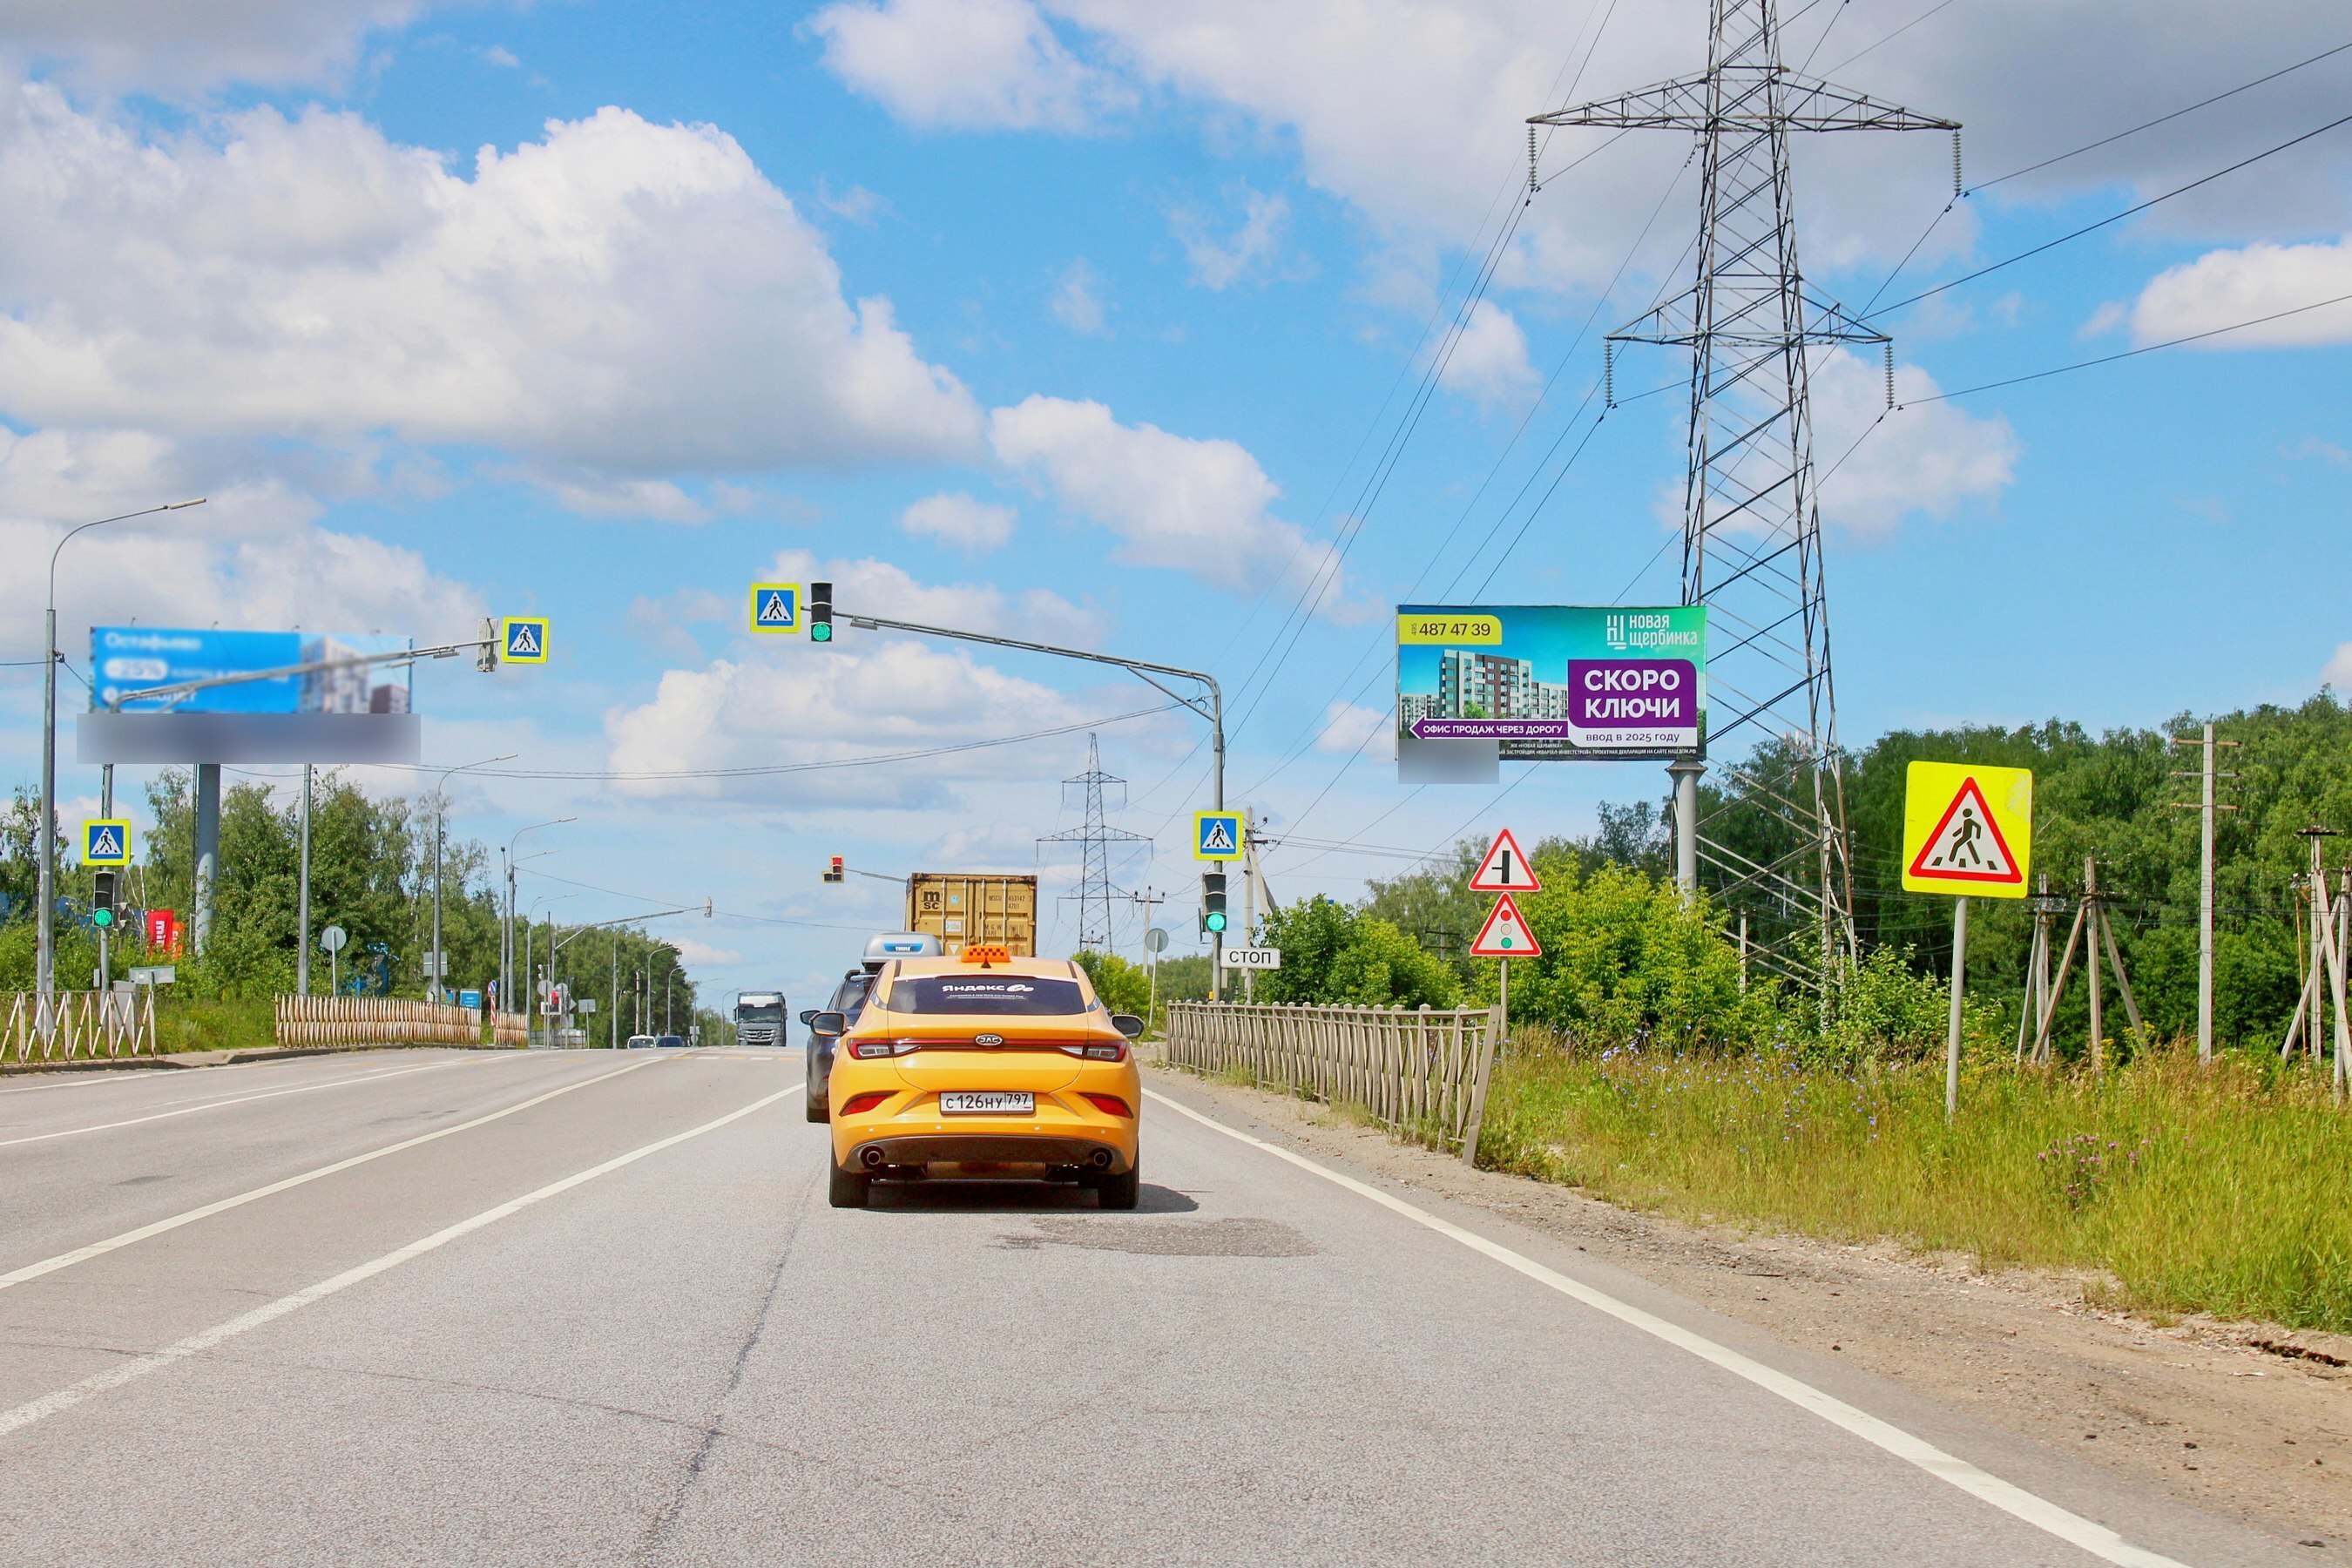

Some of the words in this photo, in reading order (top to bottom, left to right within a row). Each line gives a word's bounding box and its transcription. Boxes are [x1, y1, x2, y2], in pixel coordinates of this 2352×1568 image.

[1629, 614, 1670, 629] новая
[1419, 623, 1447, 636] 487
[1450, 623, 1468, 636] 47
[1471, 623, 1491, 636] 39
[1629, 629, 1698, 649] щербинка
[1584, 669, 1680, 692] СКОРО
[1585, 698, 1680, 719] КЛЮЧИ
[1423, 725, 1451, 734] ОФИС
[1452, 725, 1494, 735] ПРОДАЖ
[1497, 725, 1524, 734] ЧЕРЕЗ
[1525, 725, 1564, 735] ДОРОГУ
[1585, 733, 1613, 742] ввод
[1625, 733, 1652, 742] 2025
[1654, 733, 1680, 743] году
[1229, 950, 1271, 964] СТОП
[1006, 1093, 1029, 1105] 797
